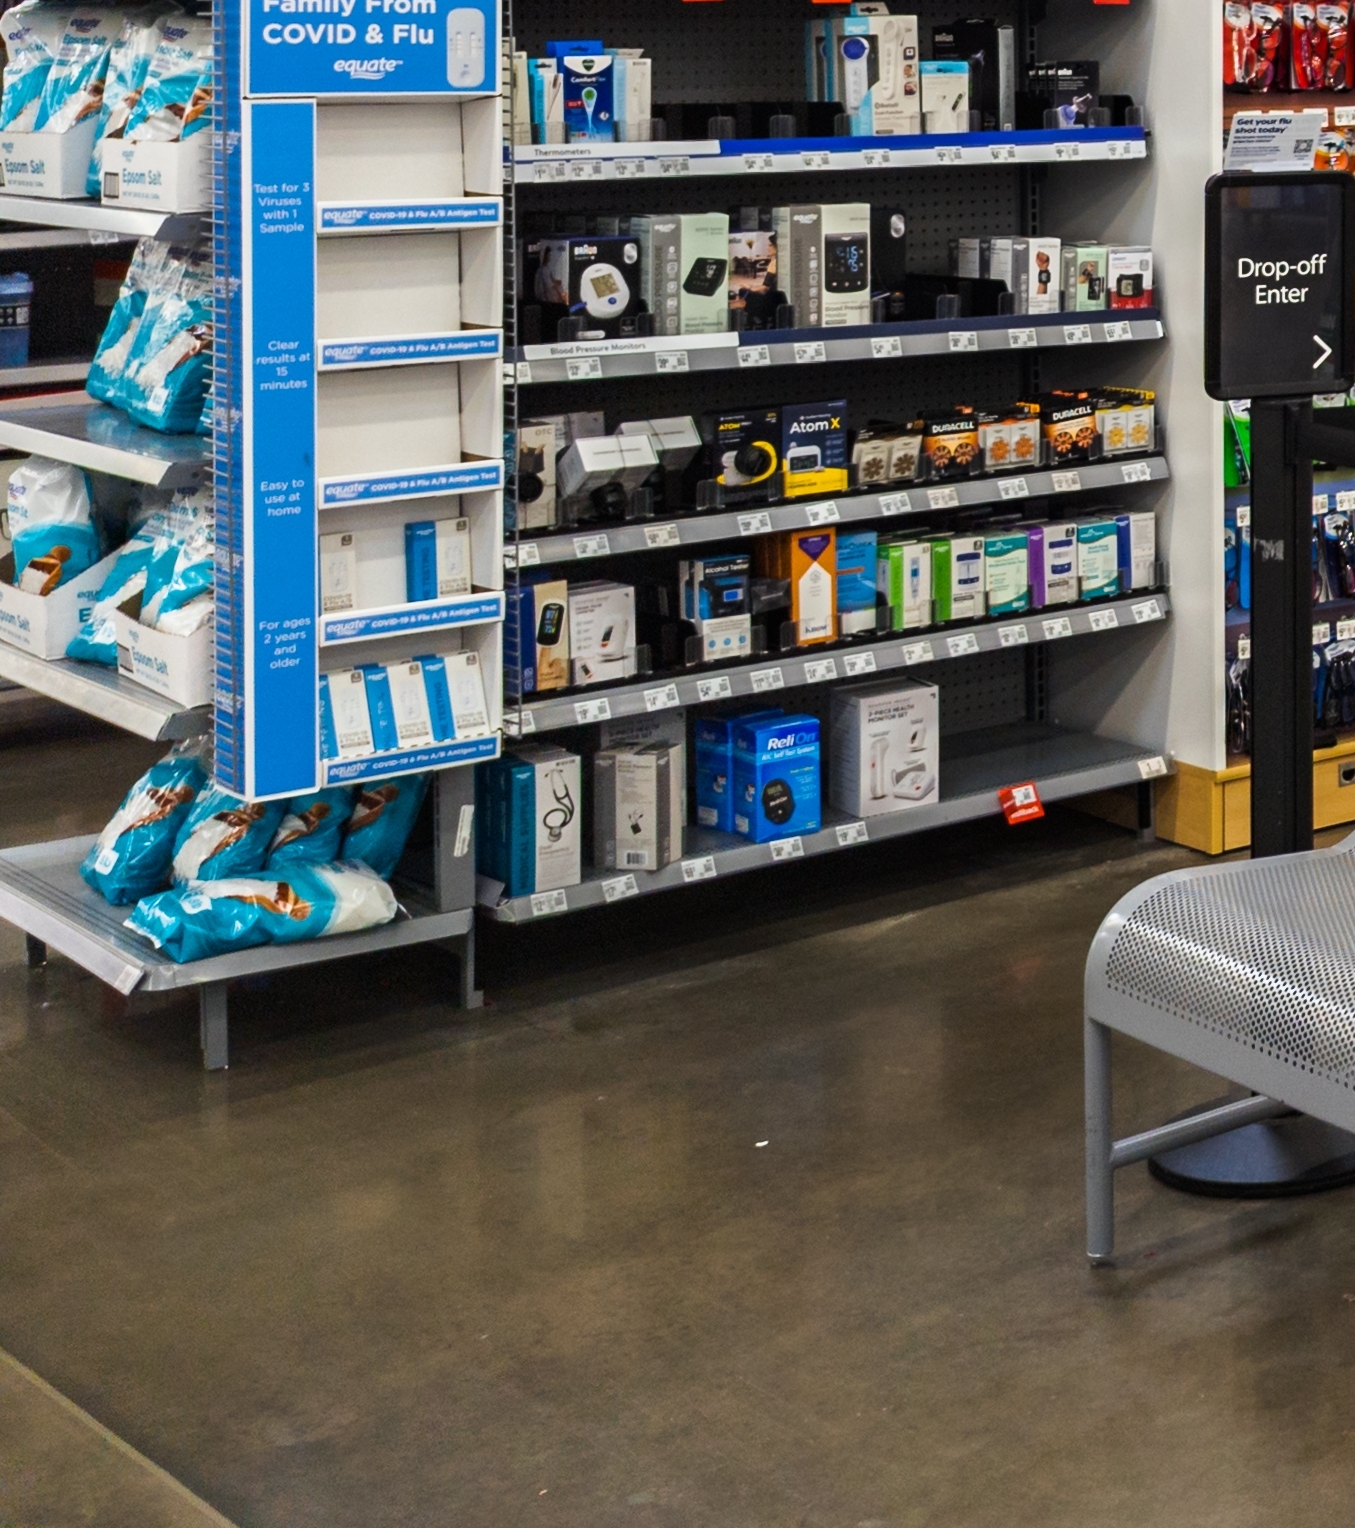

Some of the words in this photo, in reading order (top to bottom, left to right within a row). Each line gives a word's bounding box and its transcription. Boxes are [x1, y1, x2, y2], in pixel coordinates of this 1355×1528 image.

[262, 23, 357, 44] COVID
[364, 24, 385, 44] &
[392, 24, 434, 44] Flu
[333, 57, 397, 76] equate
[534, 147, 592, 157] Thermometers
[254, 183, 278, 193] Test
[281, 182, 298, 192] for
[302, 182, 310, 192] 3
[258, 196, 302, 206] Viruses
[263, 209, 290, 219] with
[293, 208, 298, 218] 1
[259, 222, 305, 233] Sample
[1237, 253, 1328, 281] Drop-off
[1254, 284, 1309, 304] Enter
[550, 346, 576, 356] Blood
[578, 344, 608, 354] Pressure
[609, 341, 647, 352] Monitors
[1052, 405, 1093, 420] DURACELL
[789, 419, 829, 434] Atom
[830, 417, 841, 429] X
[931, 420, 976, 433] DURACELL
